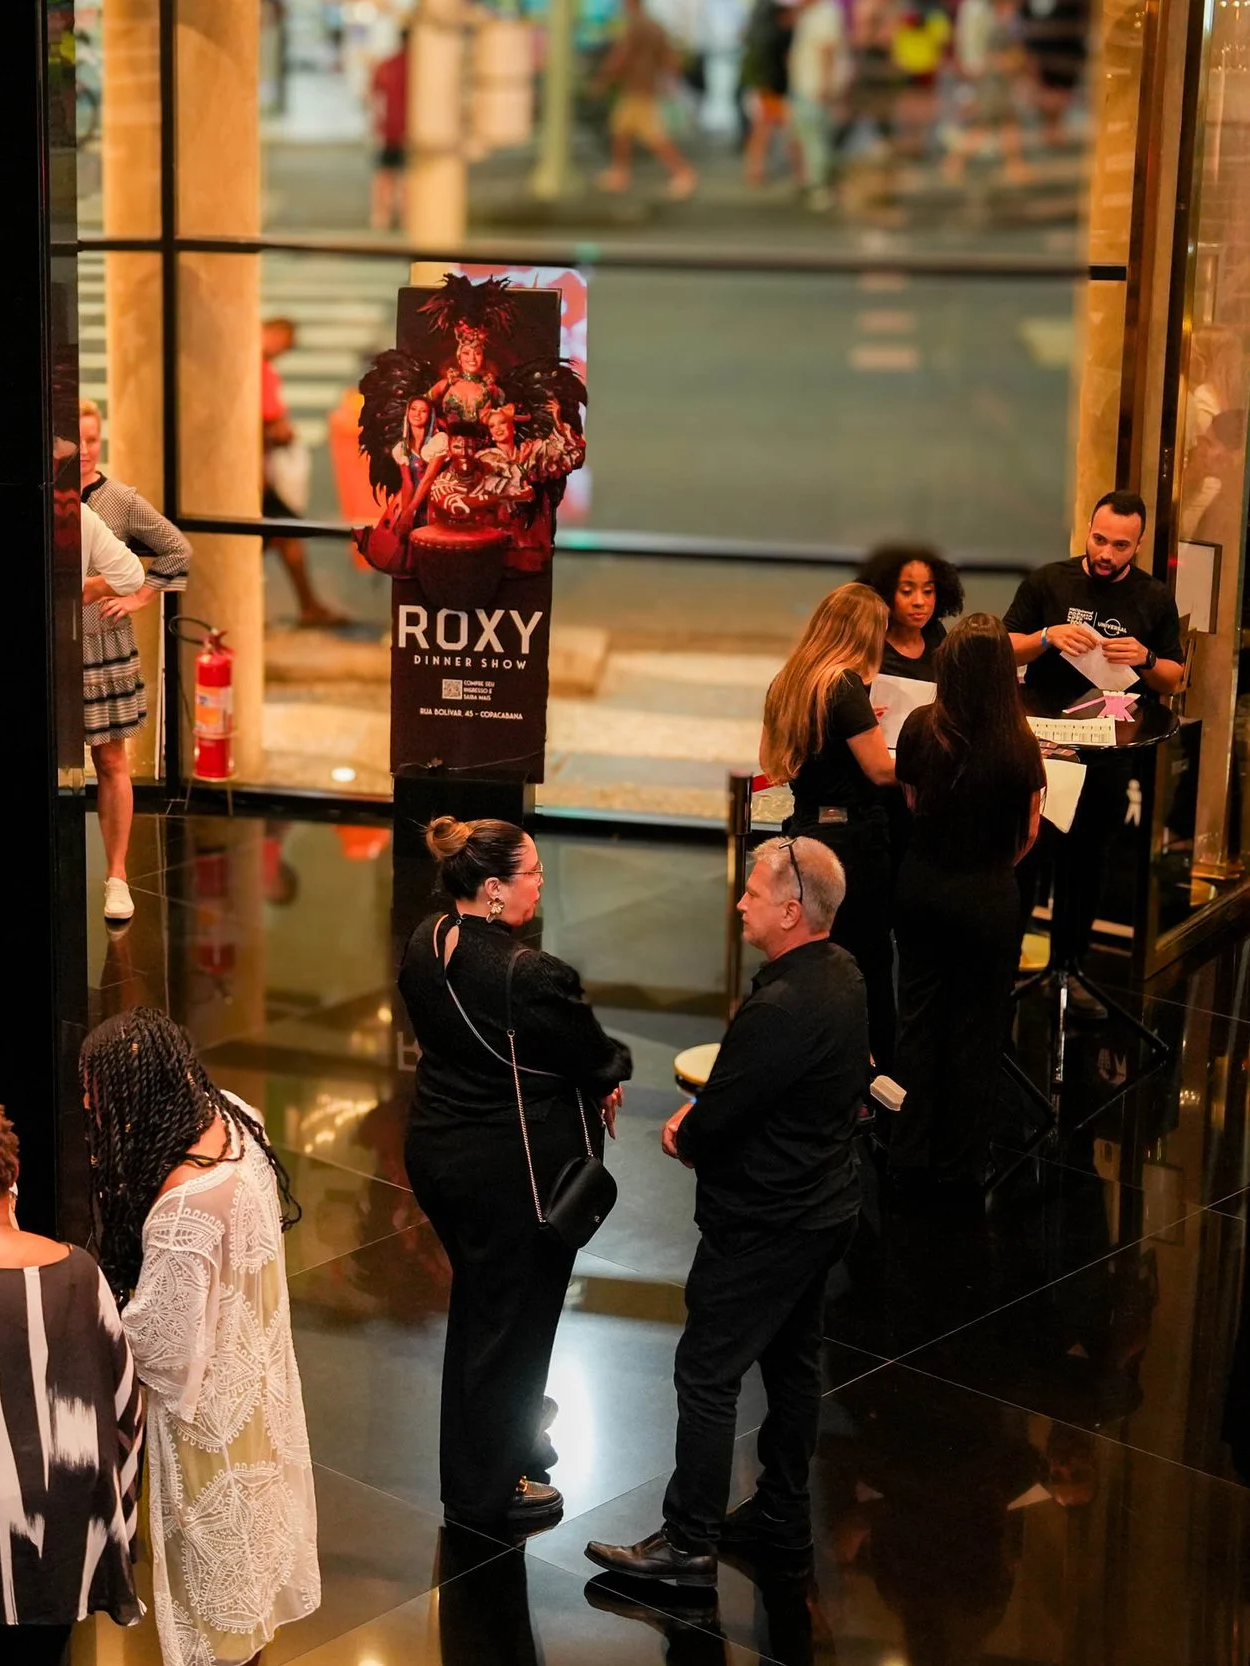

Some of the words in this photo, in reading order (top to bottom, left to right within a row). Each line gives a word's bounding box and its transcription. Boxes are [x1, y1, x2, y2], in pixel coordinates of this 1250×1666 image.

[398, 604, 543, 654] ROXY
[1097, 621, 1127, 633] UNIVERSAL
[414, 654, 472, 667] DINNER
[481, 658, 527, 670] SHOW
[419, 707, 433, 715] RUA
[480, 711, 523, 720] COPACABANA
